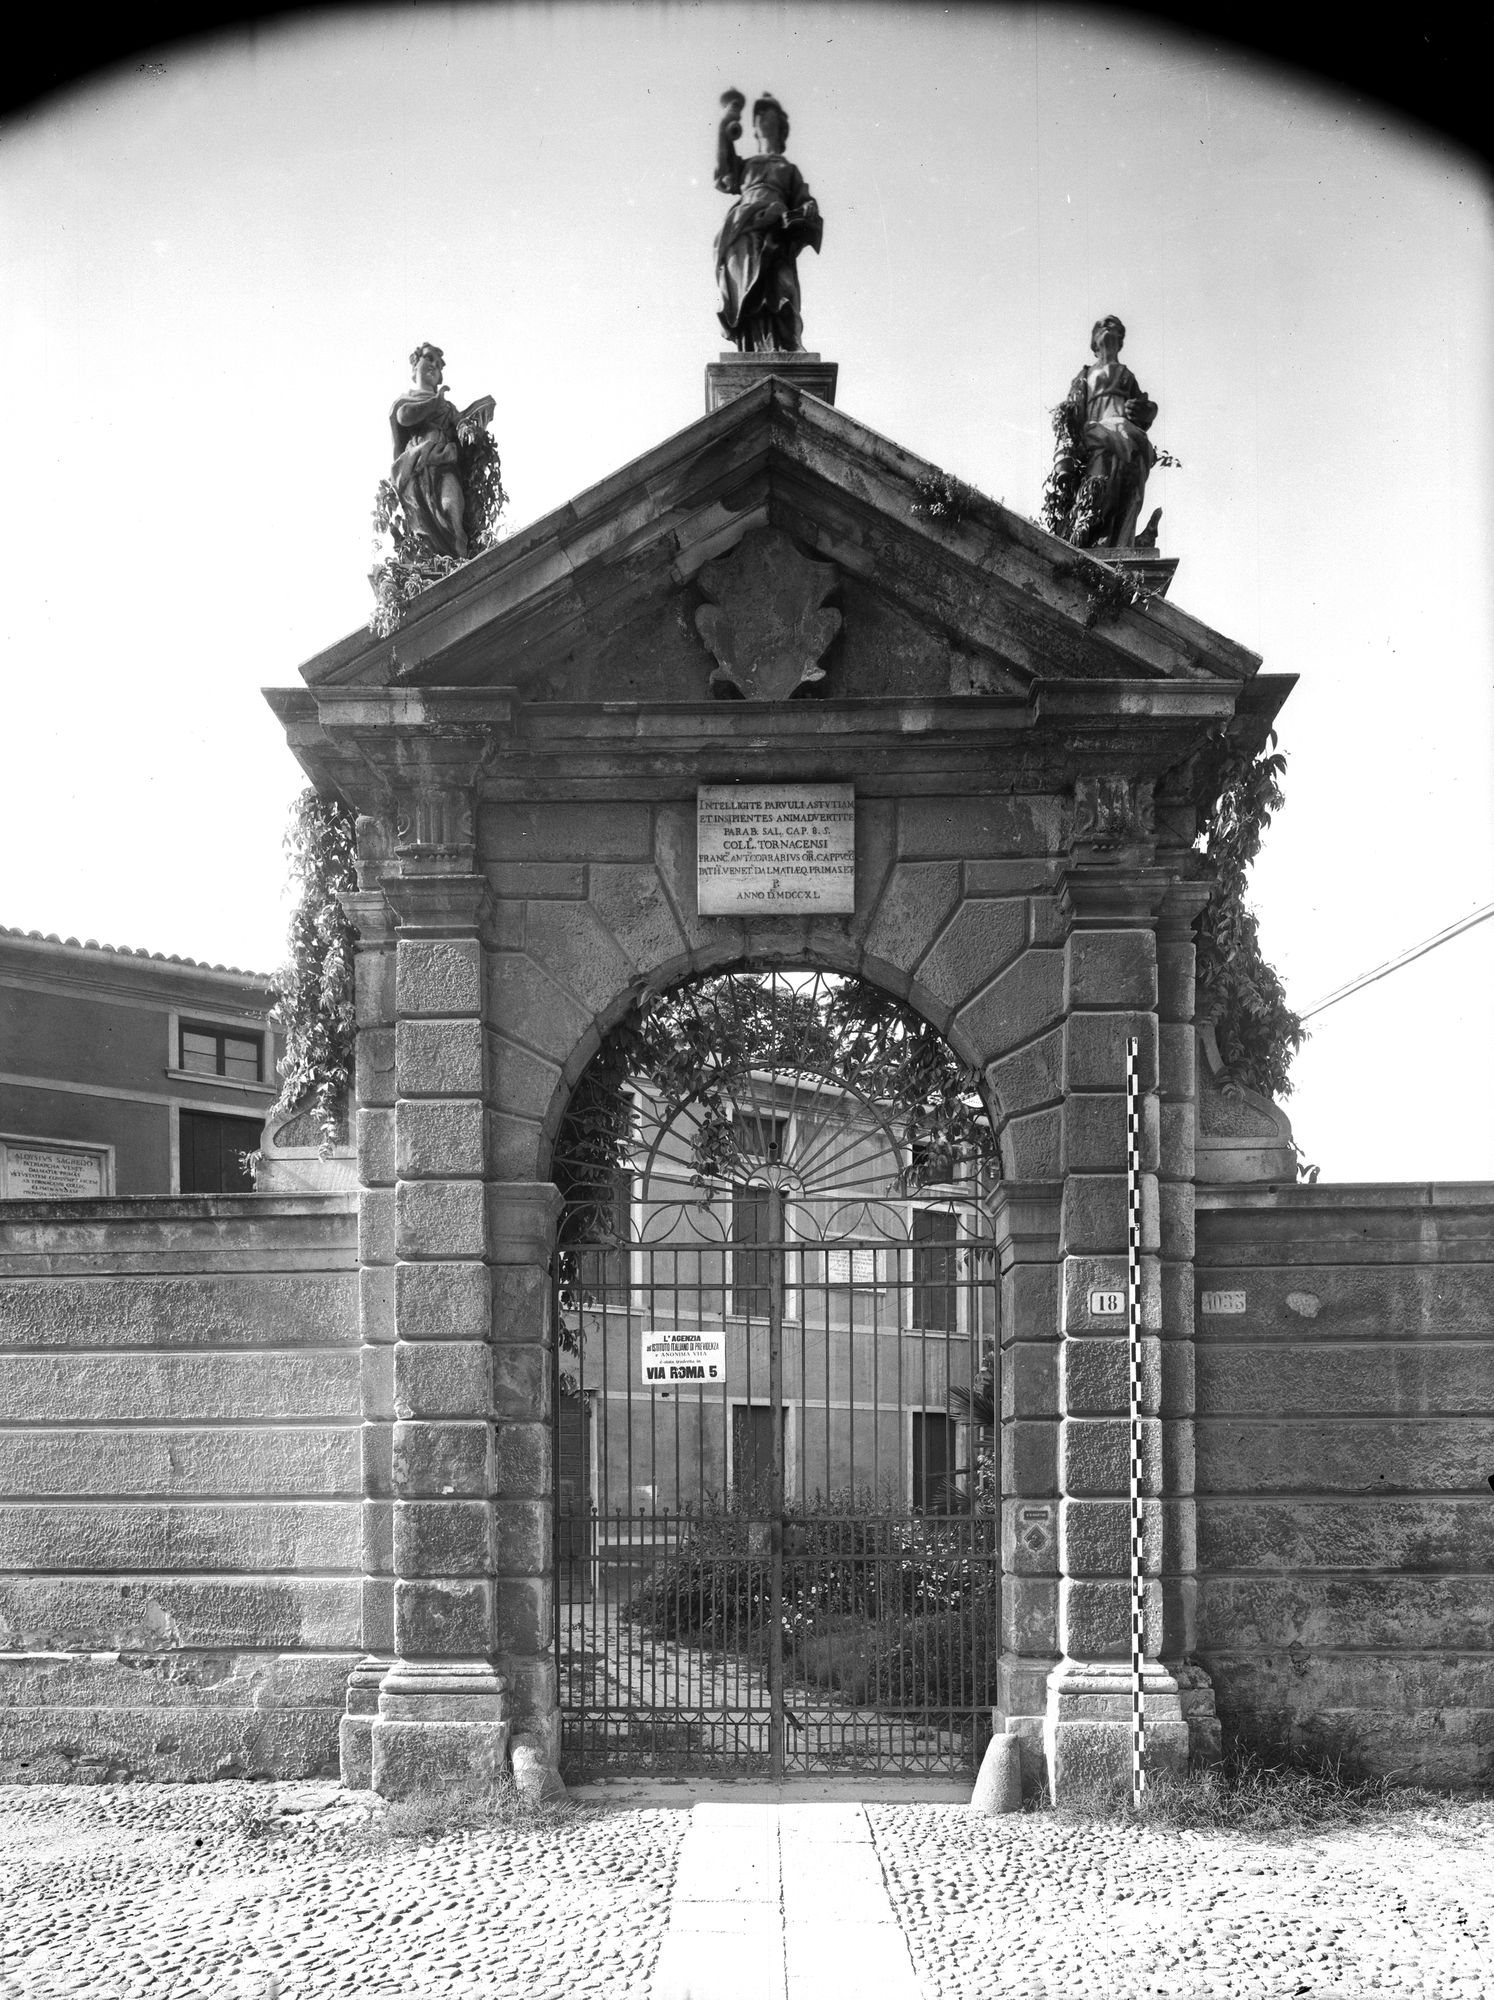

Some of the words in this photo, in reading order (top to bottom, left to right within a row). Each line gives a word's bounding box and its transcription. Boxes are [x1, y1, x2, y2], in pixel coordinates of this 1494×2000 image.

[758, 840, 828, 849] TORNACENSI
[736, 891, 764, 899] ANNO
[1098, 1295, 1117, 1311] 18
[671, 1343, 689, 1351] ITALIANO
[695, 1342, 719, 1350] PREVIDENZA
[647, 1367, 665, 1379] VIA
[670, 1366, 705, 1378] ROMA
[709, 1365, 717, 1377] 5
